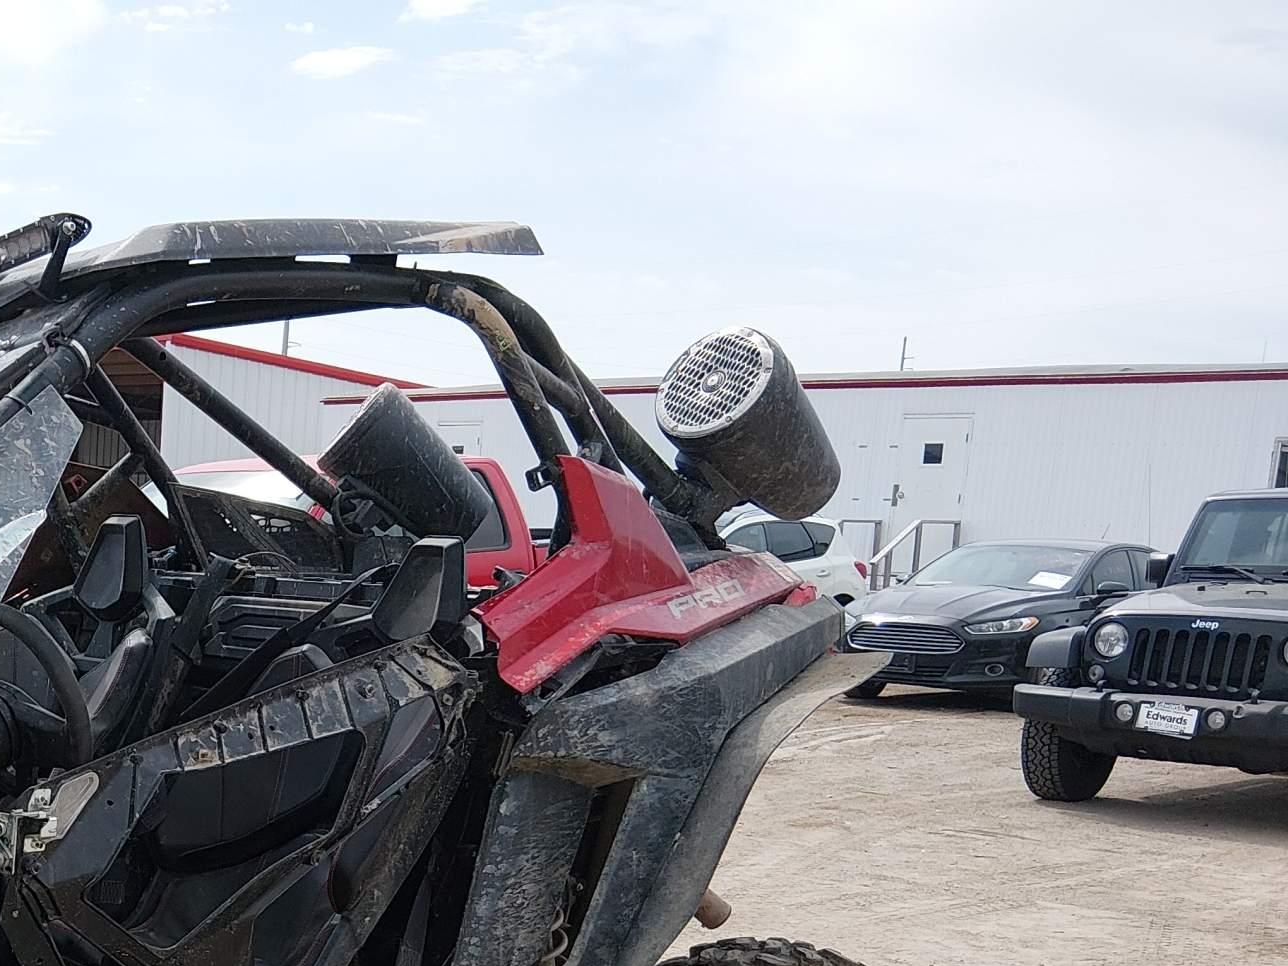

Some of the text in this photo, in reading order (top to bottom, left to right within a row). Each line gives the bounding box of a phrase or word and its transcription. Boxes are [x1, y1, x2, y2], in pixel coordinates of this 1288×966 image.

[667, 579, 746, 619] PRO
[1191, 619, 1220, 631] Jeep
[1145, 710, 1189, 726] Edwards
